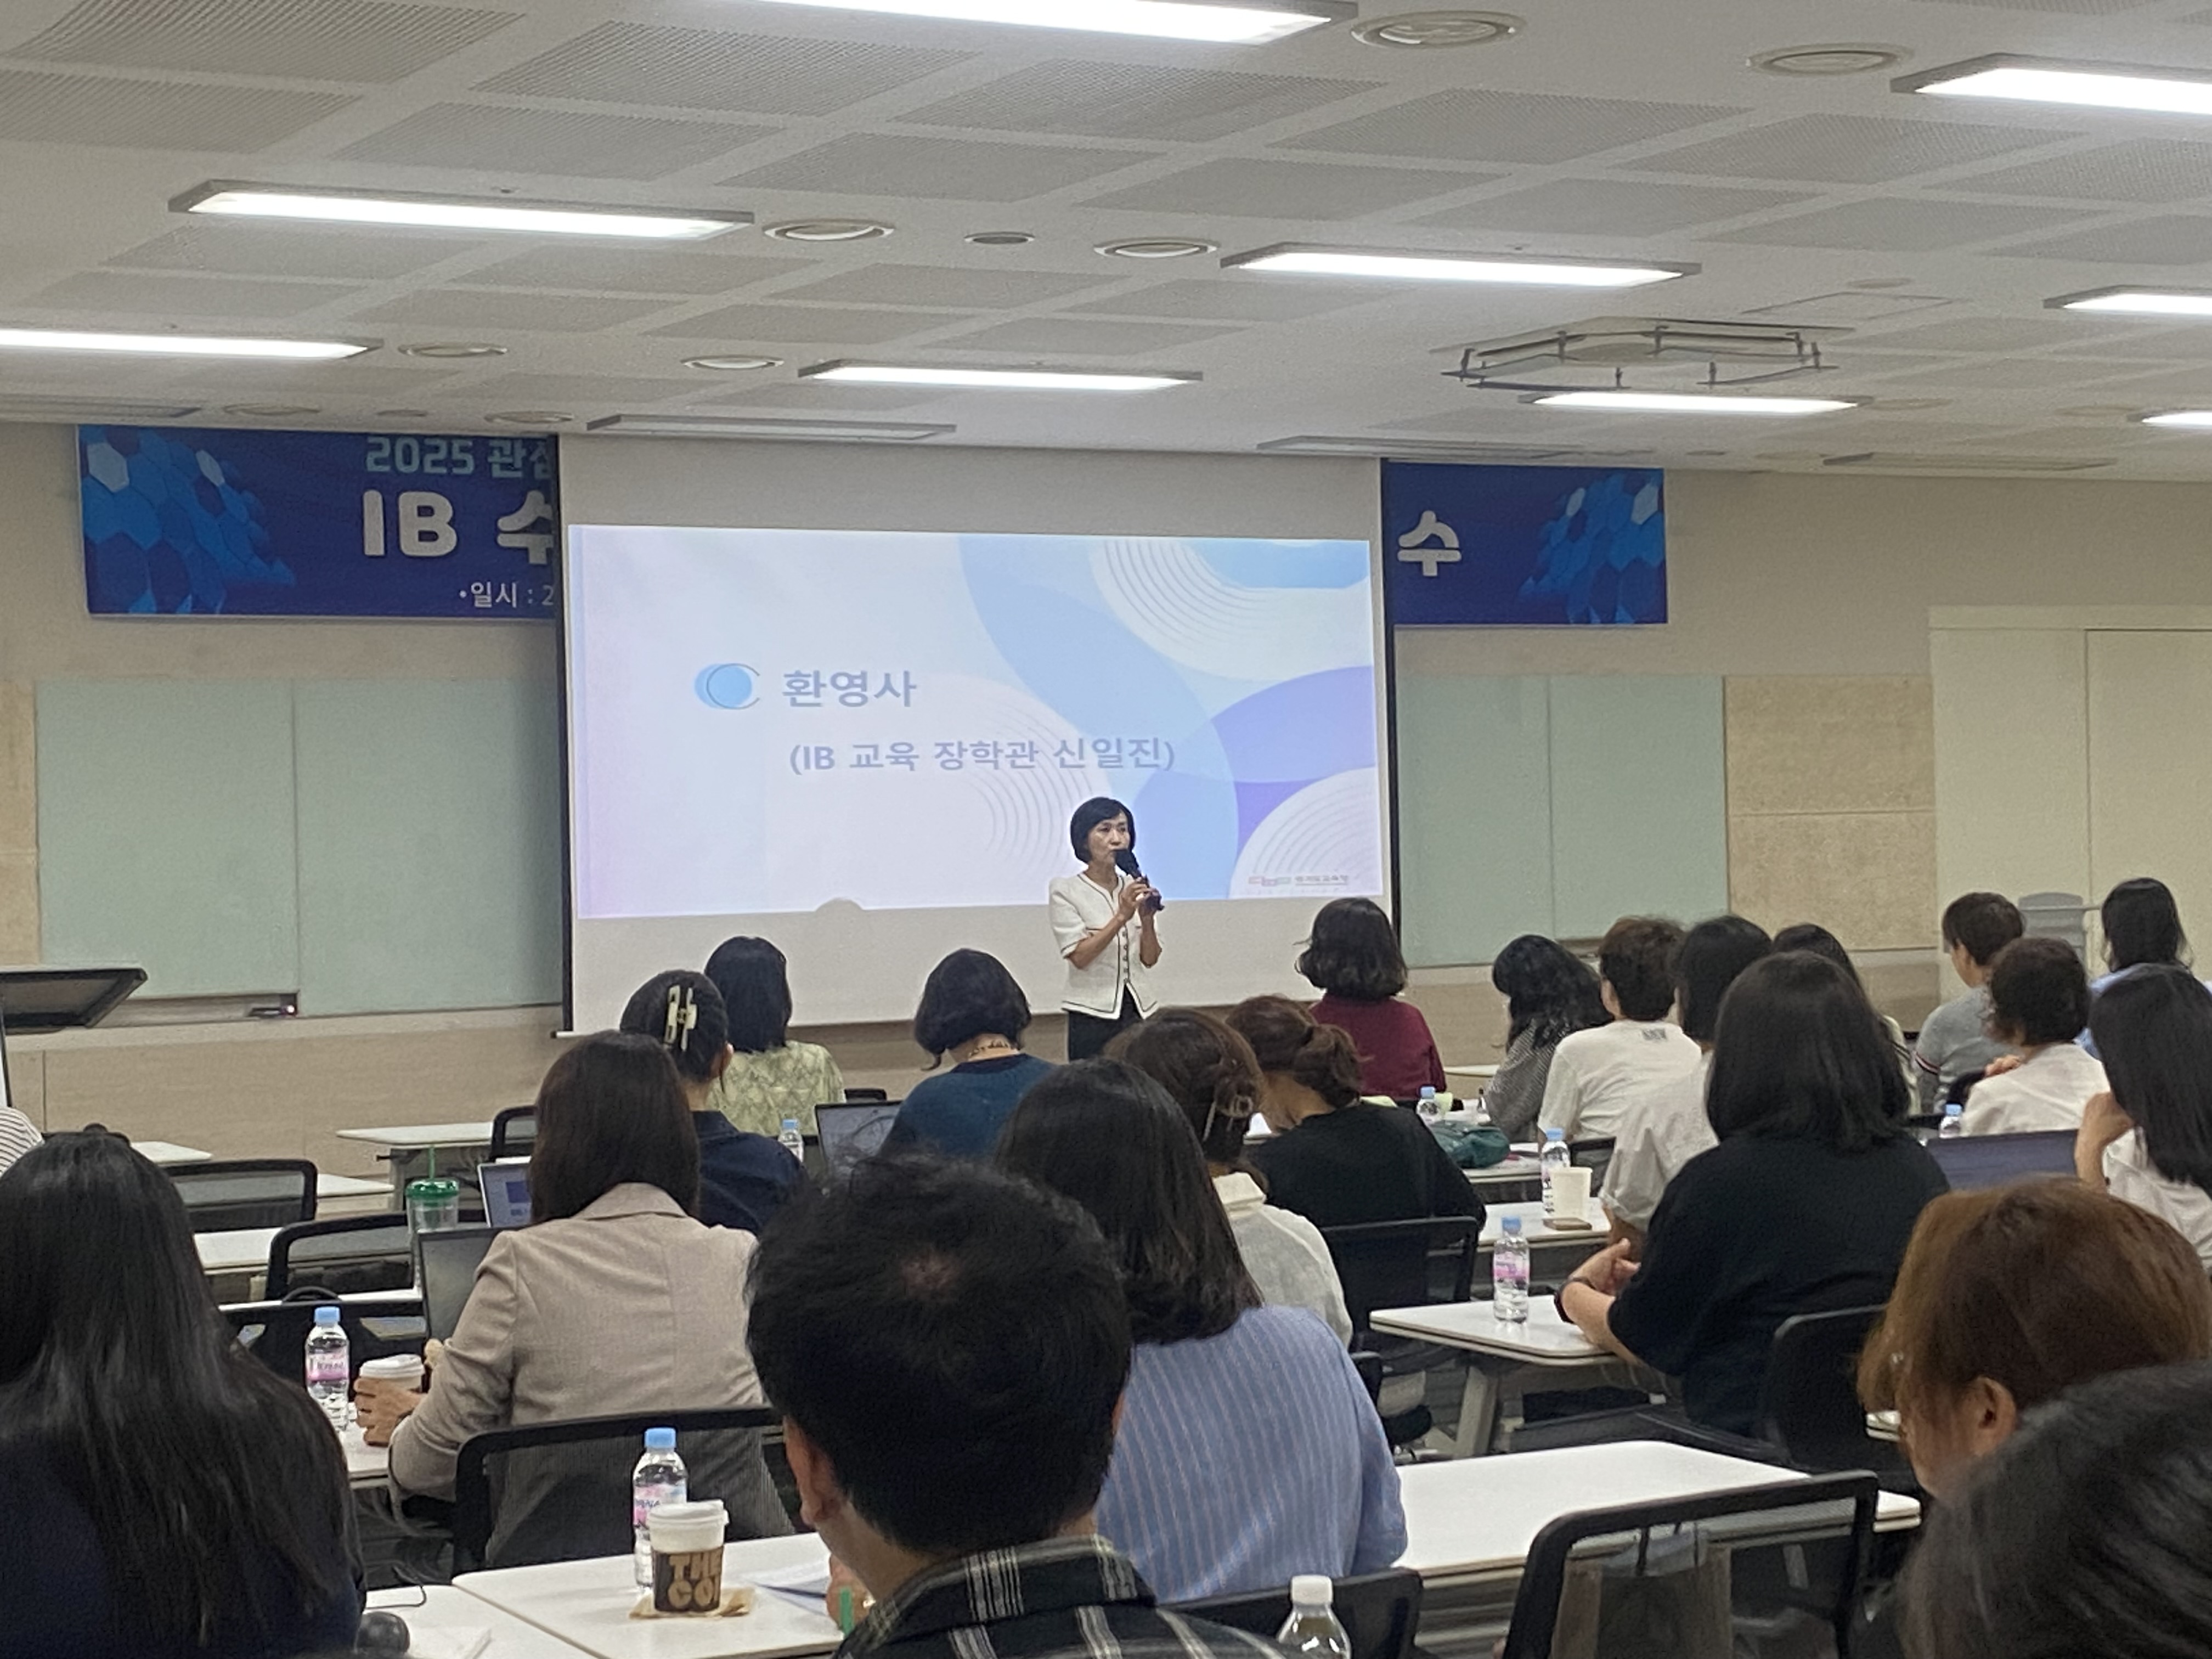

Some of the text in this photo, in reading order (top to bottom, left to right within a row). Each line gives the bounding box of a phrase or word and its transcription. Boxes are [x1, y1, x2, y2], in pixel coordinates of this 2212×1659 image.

[365, 436, 475, 475] 2025
[363, 489, 554, 565] IB 수
[1397, 510, 1462, 577] 수
[782, 670, 918, 708] 환영사
[790, 737, 1175, 775] (IB 교육 장학관 신일진)
